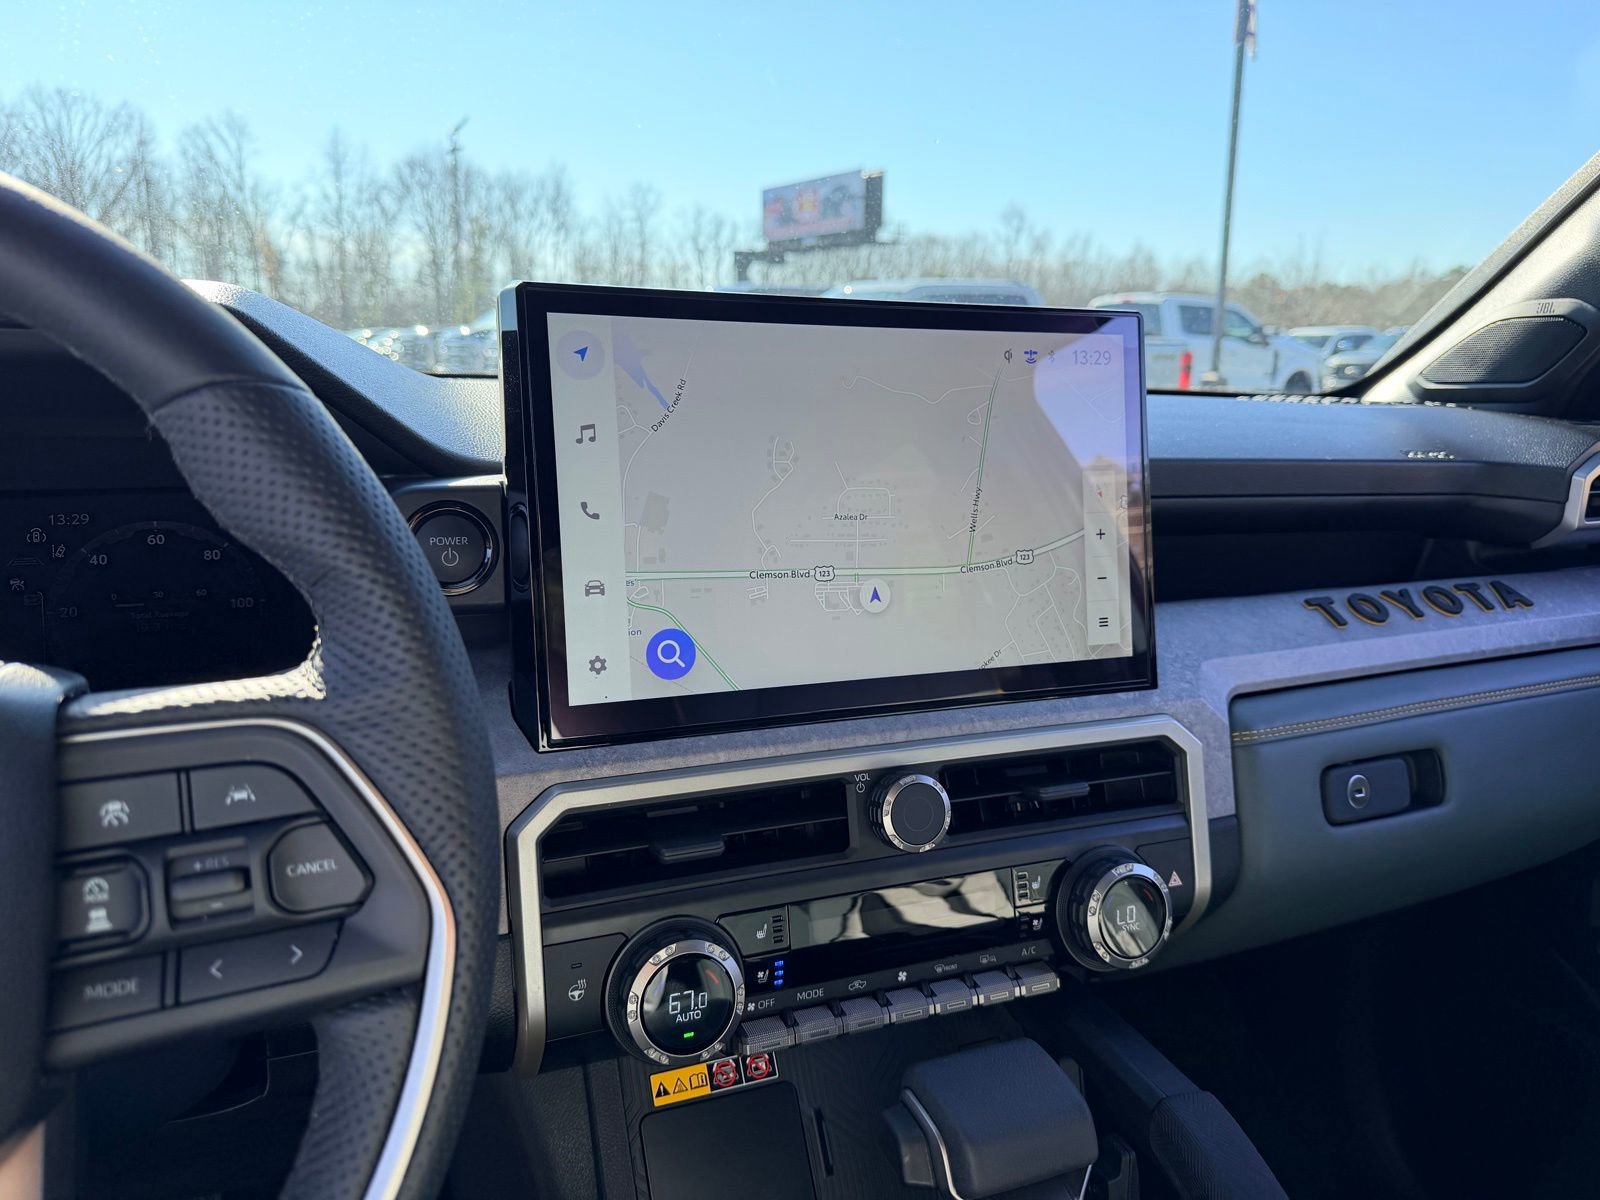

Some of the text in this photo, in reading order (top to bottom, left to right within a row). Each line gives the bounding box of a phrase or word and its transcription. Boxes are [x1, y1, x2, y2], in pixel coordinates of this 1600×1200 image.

[1072, 350, 1112, 365] 13:29
[650, 378, 687, 433] Davis Creek Rd
[968, 486, 983, 533] Wells Hwy
[48, 513, 90, 526] 13:29
[834, 513, 868, 521] Azalea Dr
[147, 534, 165, 545] 60
[429, 536, 469, 546] POWER
[89, 554, 107, 565] 40
[203, 550, 221, 561] 80
[1019, 553, 1030, 561] 123
[959, 558, 1014, 575] Clemson Blvd
[749, 569, 811, 580] Clemson Blvd
[818, 570, 831, 578] 123
[231, 597, 254, 608] 100
[1302, 580, 1534, 629] TOYOTA
[60, 606, 78, 618] 20
[993, 649, 1002, 658] Dr
[854, 773, 870, 782] VOL
[286, 858, 338, 877] CANCEL
[1121, 922, 1140, 931] SYNC
[1021, 945, 1036, 956] A/C
[84, 978, 139, 998] MODE
[796, 988, 825, 1001] MODE
[668, 989, 708, 1015] 67.0
[757, 999, 776, 1009] OFF
[675, 1009, 702, 1024] AUTO
